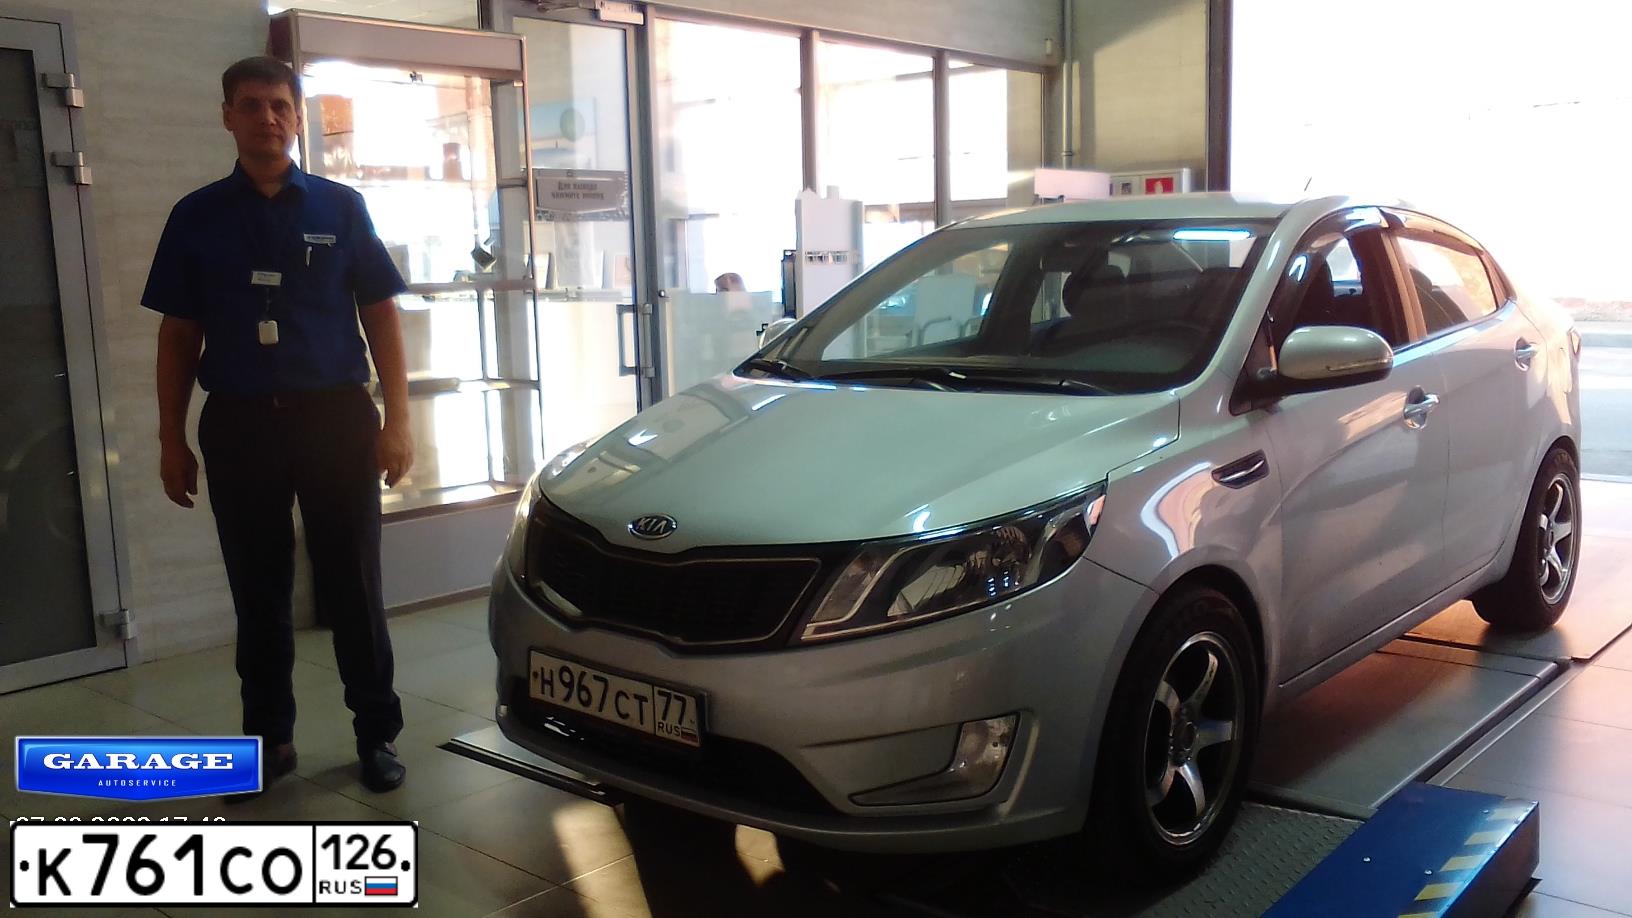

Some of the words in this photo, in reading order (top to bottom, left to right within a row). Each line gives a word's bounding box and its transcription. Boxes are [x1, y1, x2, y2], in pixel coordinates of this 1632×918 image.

[637, 518, 666, 534] KIA
[540, 665, 649, 726] Н967СТ
[657, 690, 688, 725] 77
[657, 721, 681, 737] RUS
